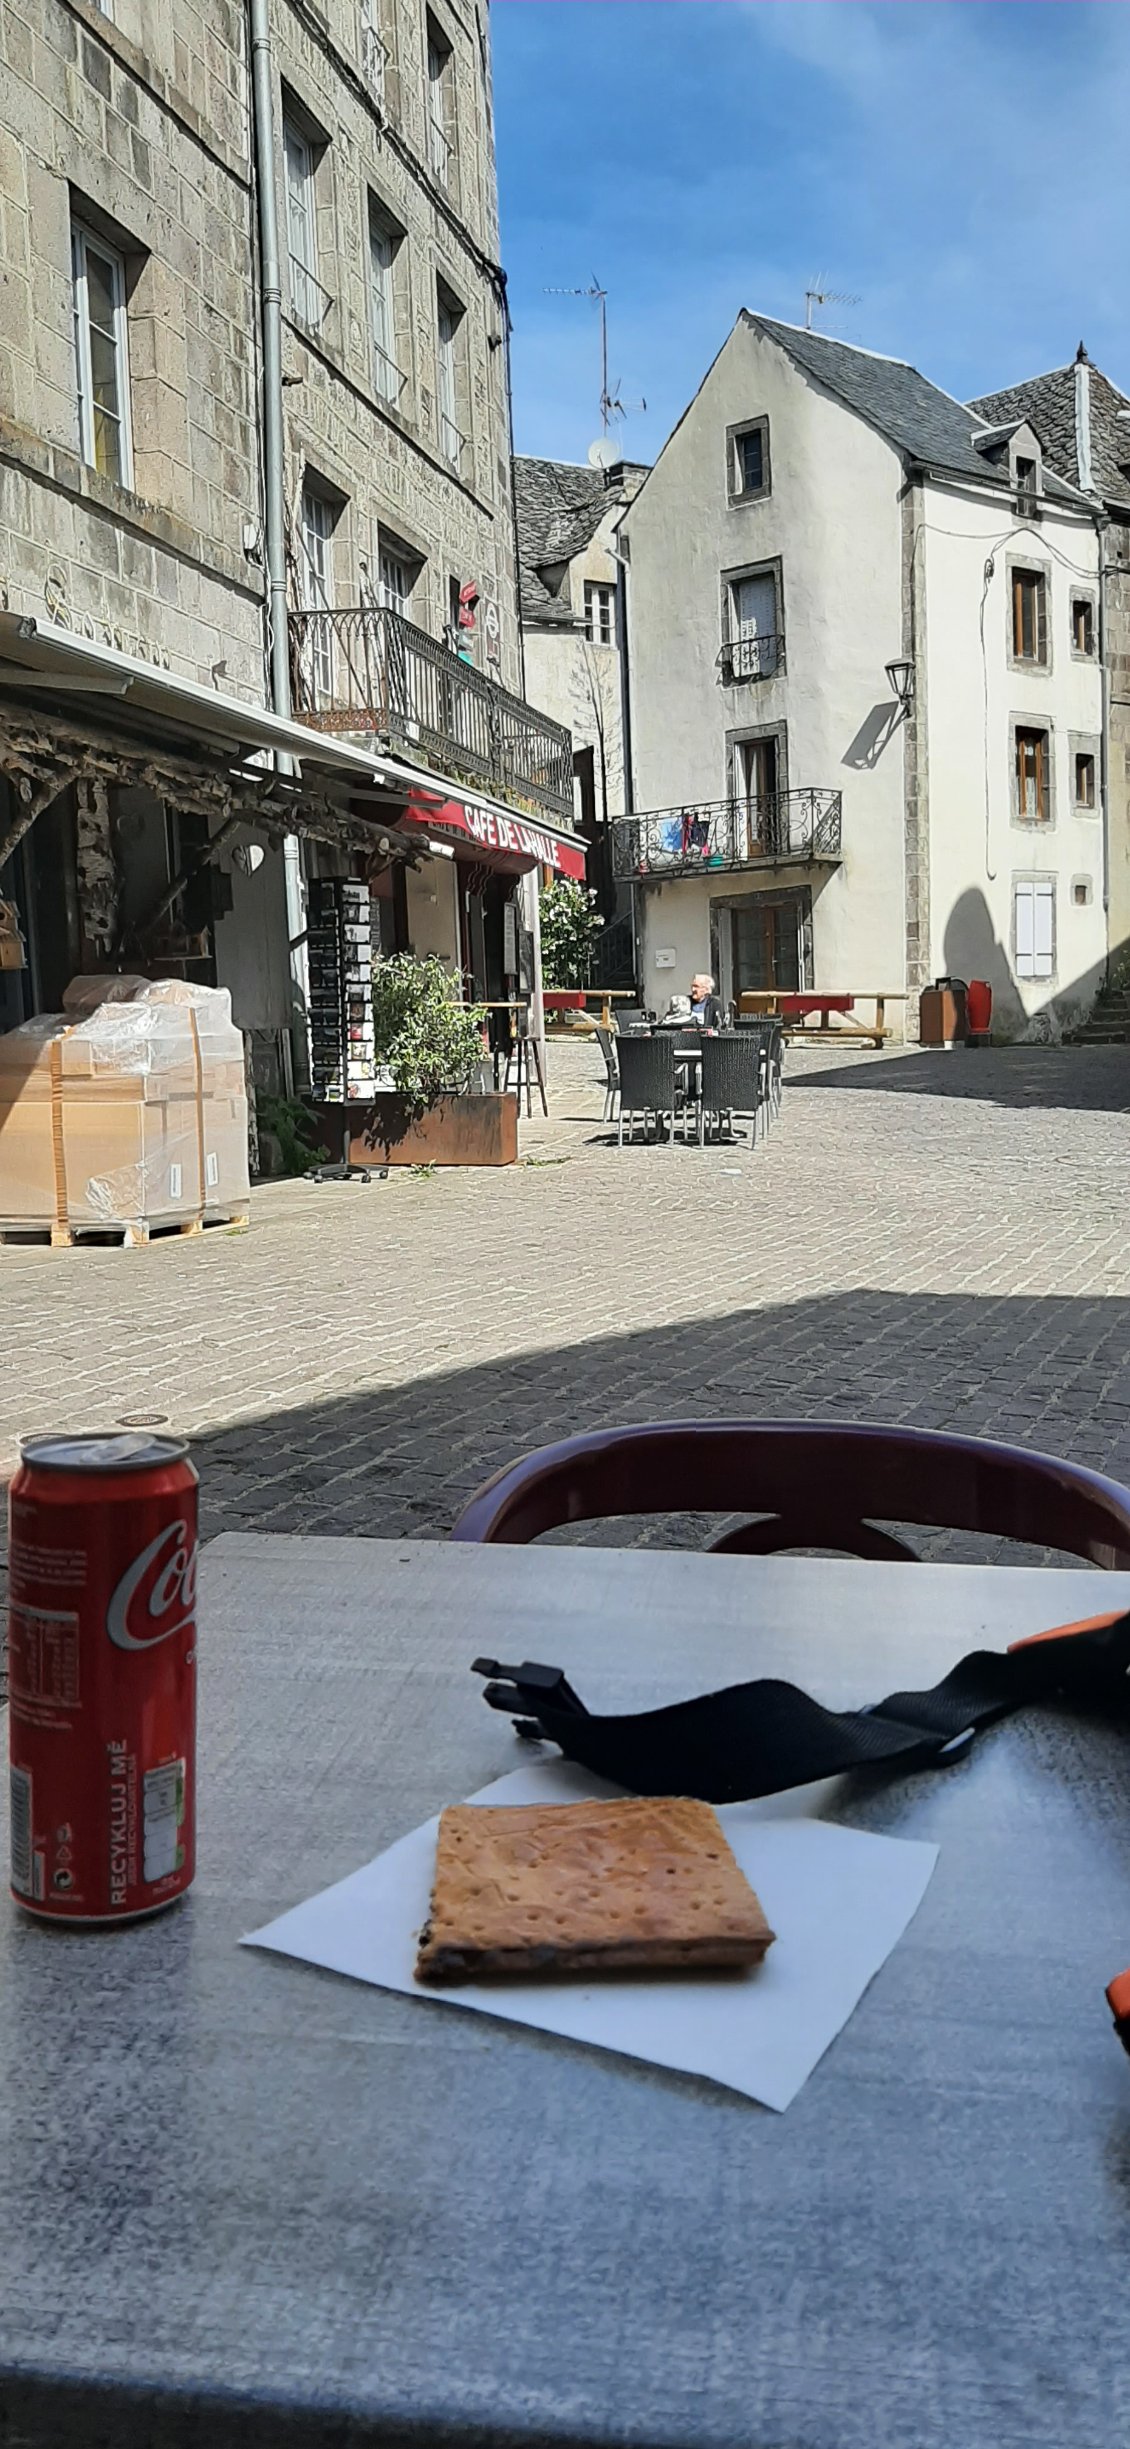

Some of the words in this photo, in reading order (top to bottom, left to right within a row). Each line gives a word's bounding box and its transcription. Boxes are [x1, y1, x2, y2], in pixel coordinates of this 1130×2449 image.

[464, 805, 497, 845] CAFE
[496, 816, 518, 850] DE
[110, 1783, 127, 1904] RECYKLUJ
